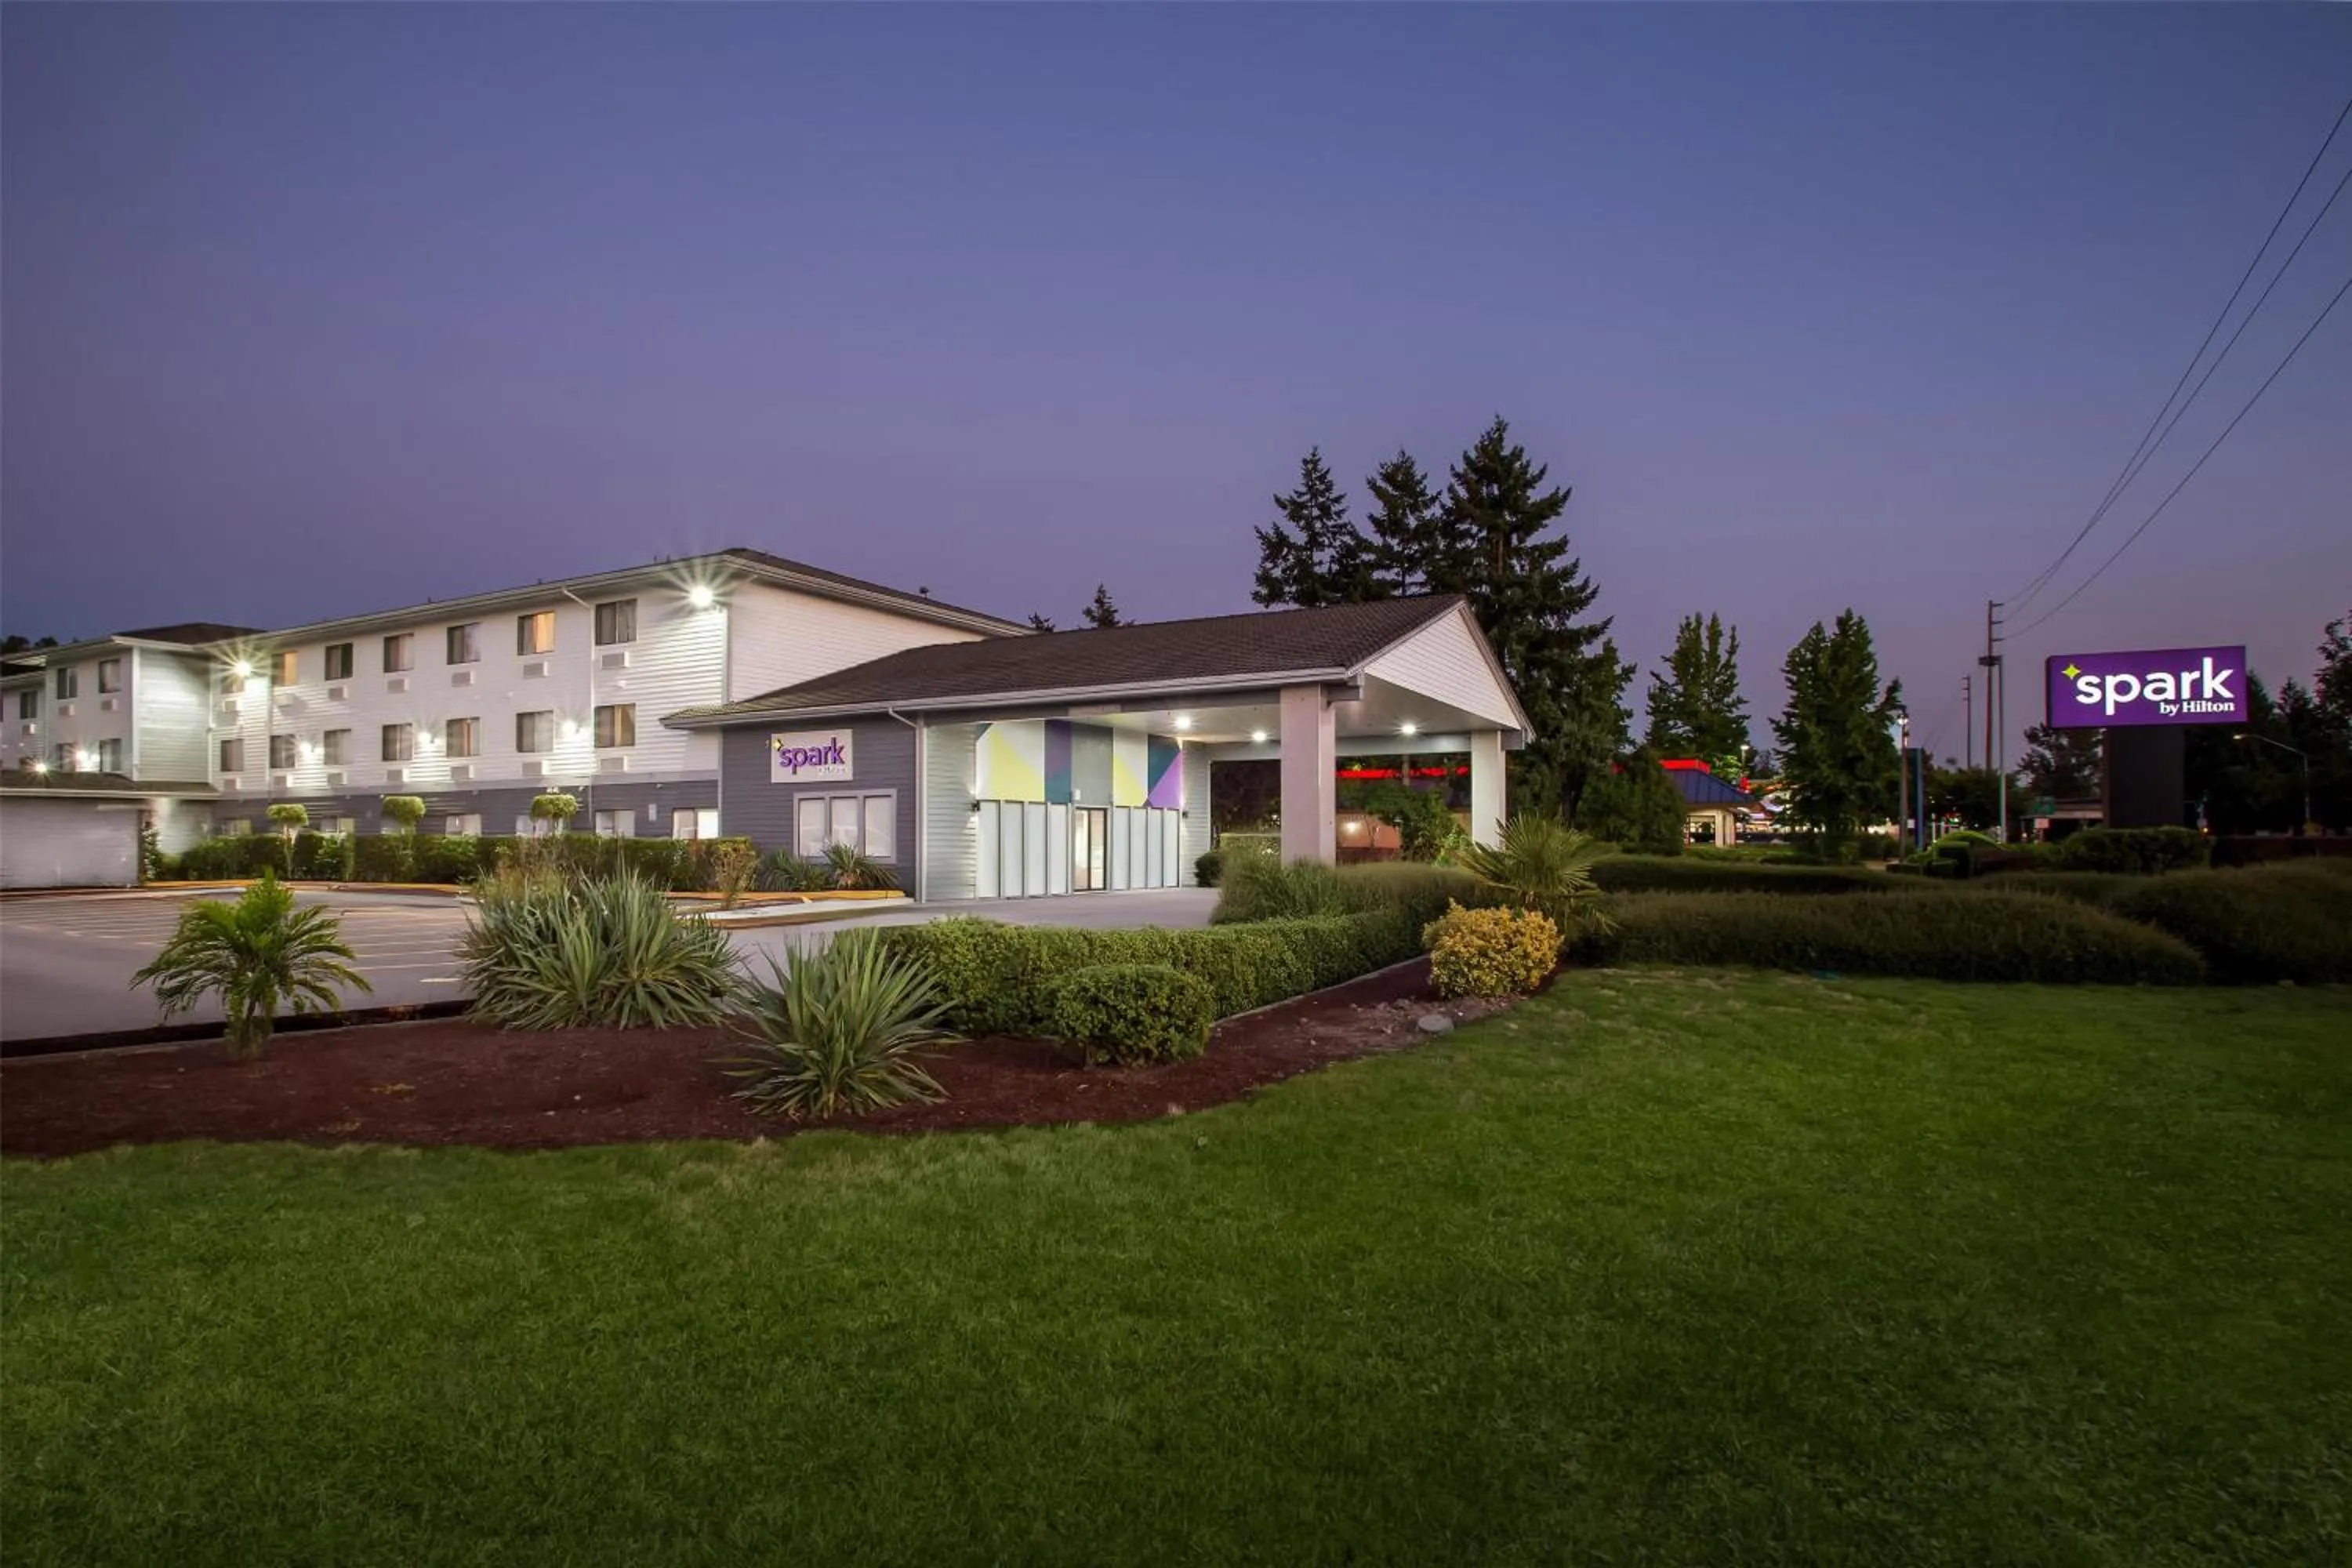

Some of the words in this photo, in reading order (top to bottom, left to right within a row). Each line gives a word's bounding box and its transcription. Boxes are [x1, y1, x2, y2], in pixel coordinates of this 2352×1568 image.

[2075, 657, 2234, 715] spark
[2159, 702, 2180, 717] by
[2182, 700, 2234, 713] Hilton
[779, 737, 845, 775] spark
